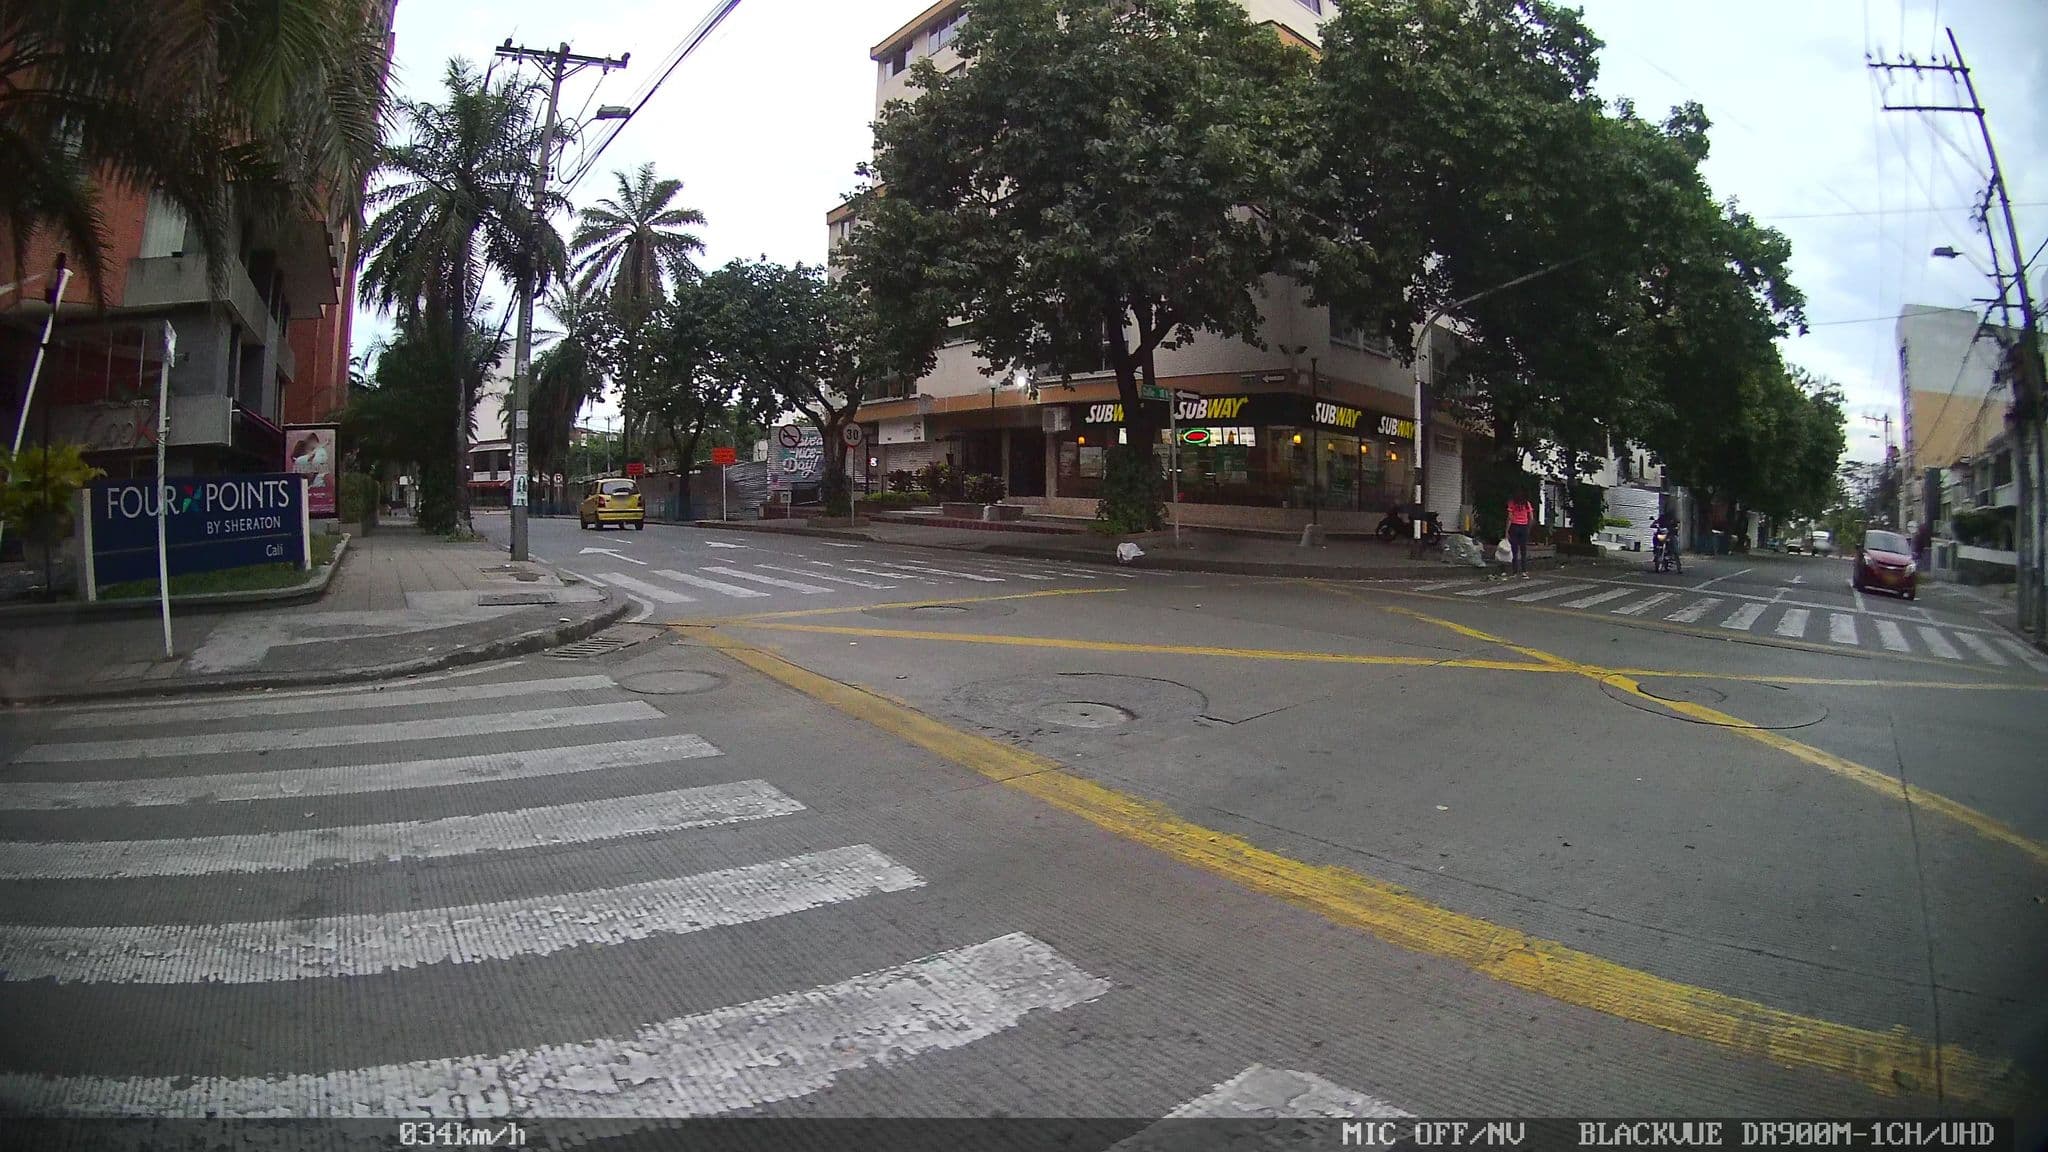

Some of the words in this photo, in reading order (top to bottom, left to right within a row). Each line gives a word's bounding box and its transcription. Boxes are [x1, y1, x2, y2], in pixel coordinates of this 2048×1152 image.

[1085, 403, 1125, 423] SUBW
[1173, 396, 1249, 420] SUBWAY
[1311, 402, 1362, 428] SUBWAY
[846, 428, 859, 438] 30
[107, 485, 180, 519] FOUR
[206, 480, 290, 512] POINTS
[206, 521, 220, 535] BY
[224, 515, 281, 533] SHERATON
[266, 544, 284, 557] Cali
